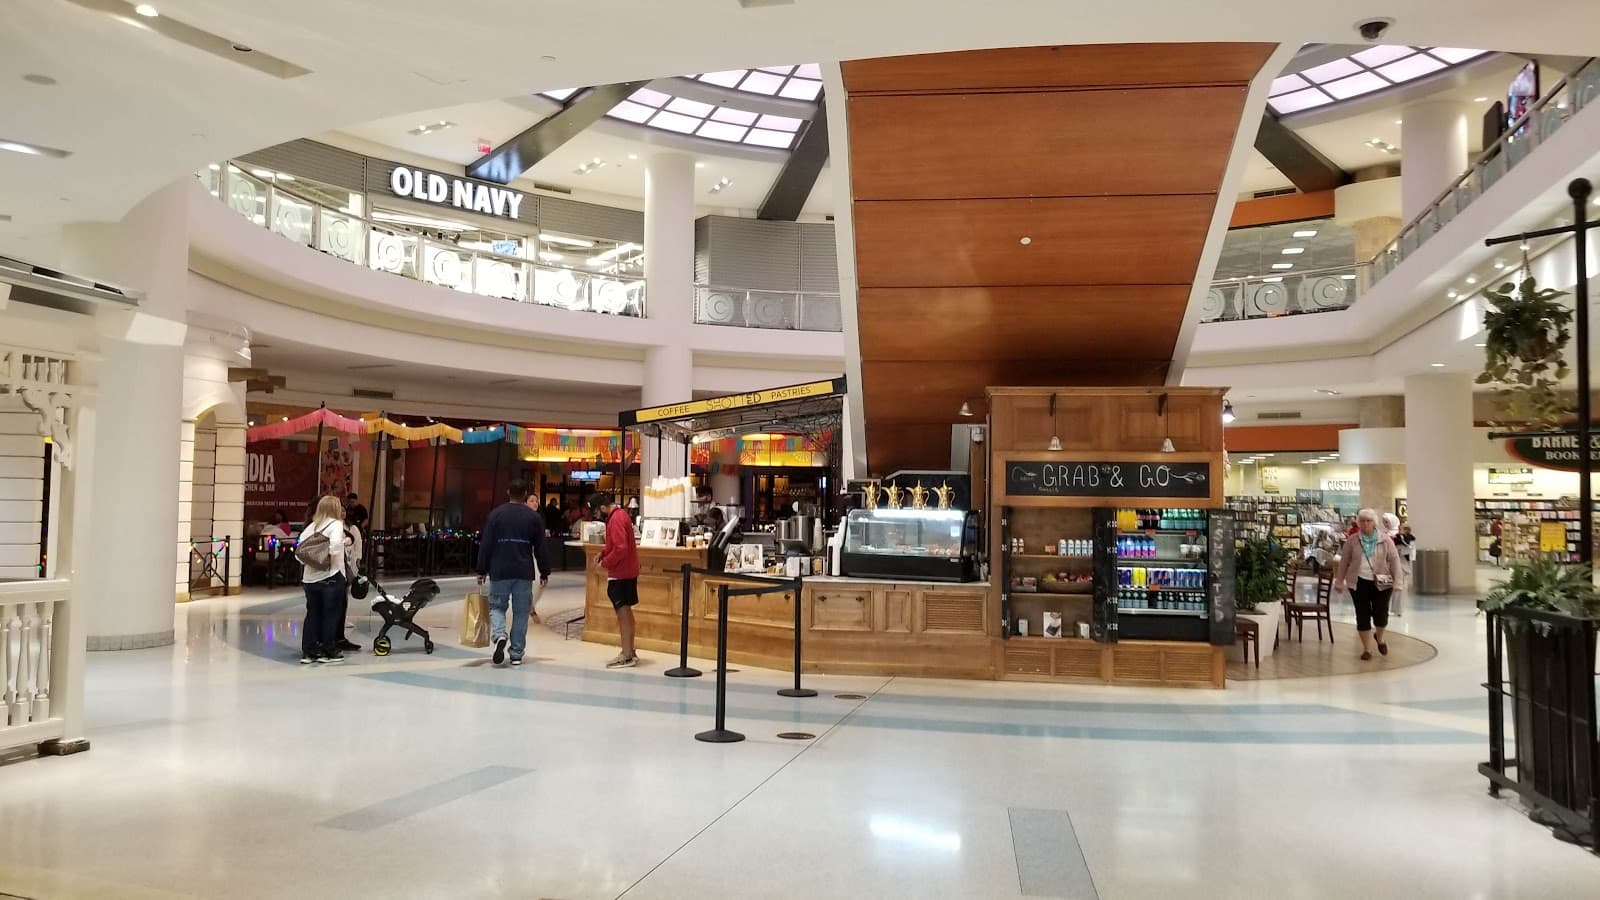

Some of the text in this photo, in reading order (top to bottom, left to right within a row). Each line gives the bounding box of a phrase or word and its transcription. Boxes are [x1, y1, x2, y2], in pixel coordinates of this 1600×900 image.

[391, 166, 523, 219] OLD NAVY
[657, 386, 811, 416] COFFEE SHOTTED PASTRIES
[1532, 435, 1580, 449] BARNE
[1042, 463, 1171, 488] GRAB & GO
